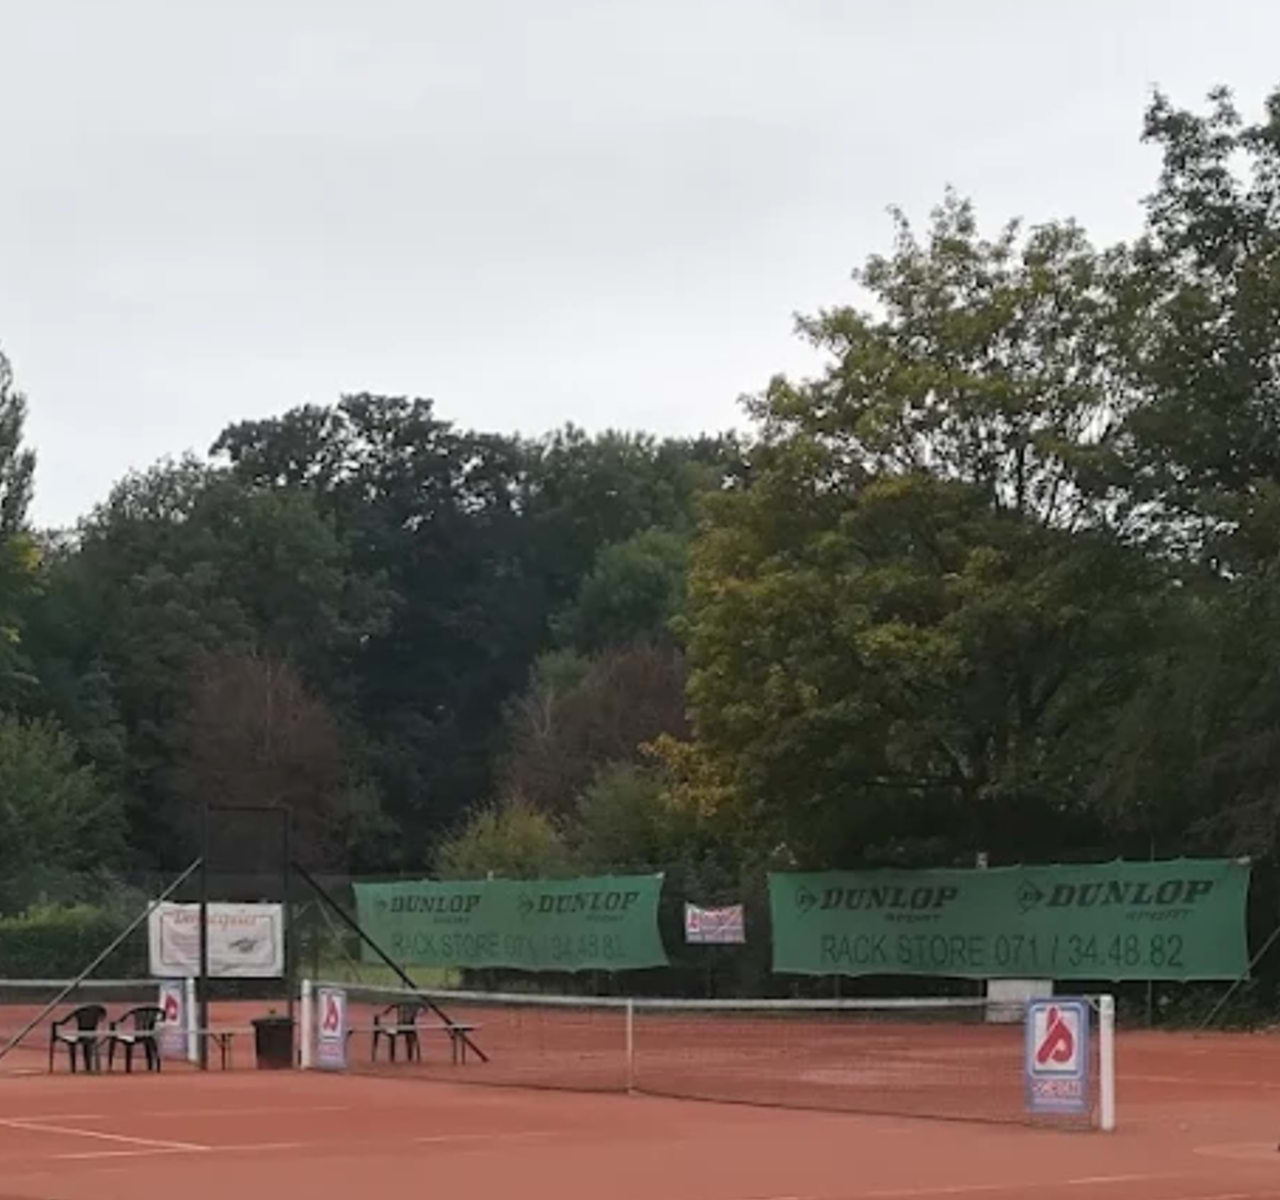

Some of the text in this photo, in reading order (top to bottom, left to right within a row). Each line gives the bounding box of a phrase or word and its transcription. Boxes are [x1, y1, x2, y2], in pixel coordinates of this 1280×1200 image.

[390, 895, 480, 914] DUNLOP
[538, 892, 640, 914] DUNLOP
[820, 884, 958, 911] DUNLOP
[1046, 880, 1215, 908] DUNLOP
[821, 934, 888, 964] RACK
[896, 934, 987, 966] STORE
[995, 934, 1039, 967] 071
[1068, 933, 1184, 967] 34.48.82
